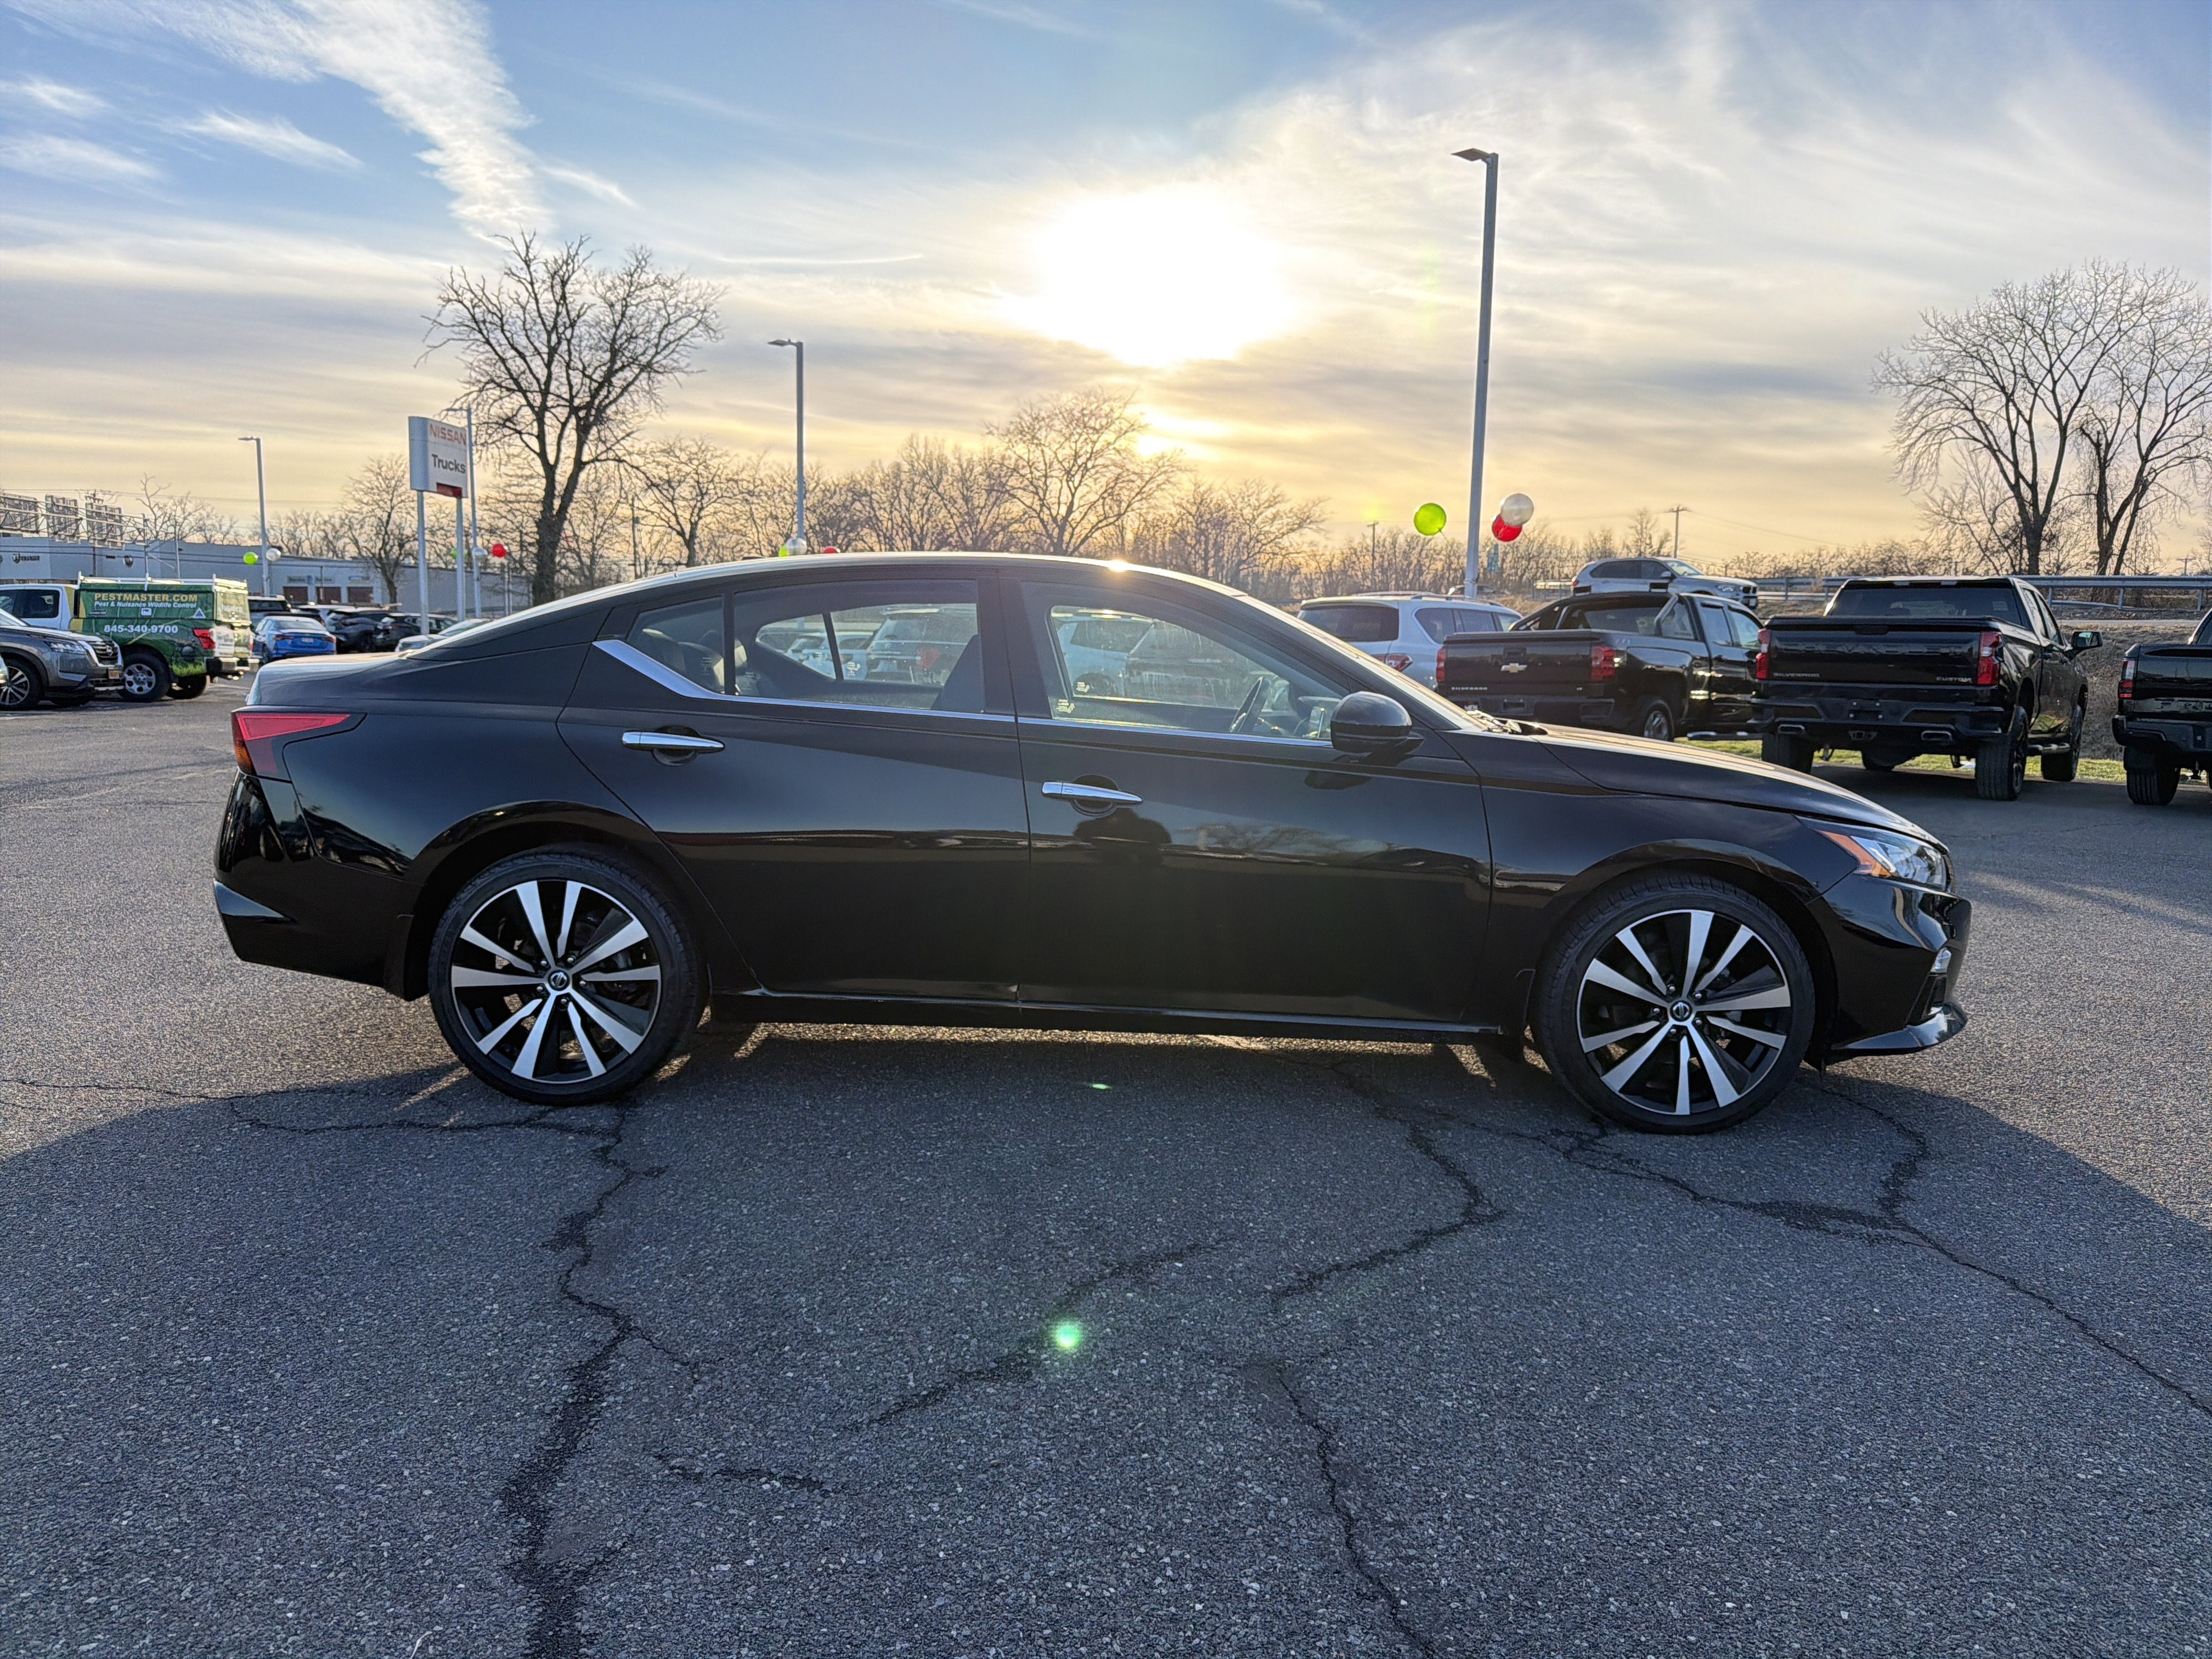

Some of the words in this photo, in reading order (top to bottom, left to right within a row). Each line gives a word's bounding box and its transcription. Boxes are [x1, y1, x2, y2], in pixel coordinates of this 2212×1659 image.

[430, 424, 467, 446] NISSAN
[432, 454, 466, 474] Trucks
[94, 593, 198, 602] PESTMASTER.COM
[104, 624, 179, 634] 845-340-9700
